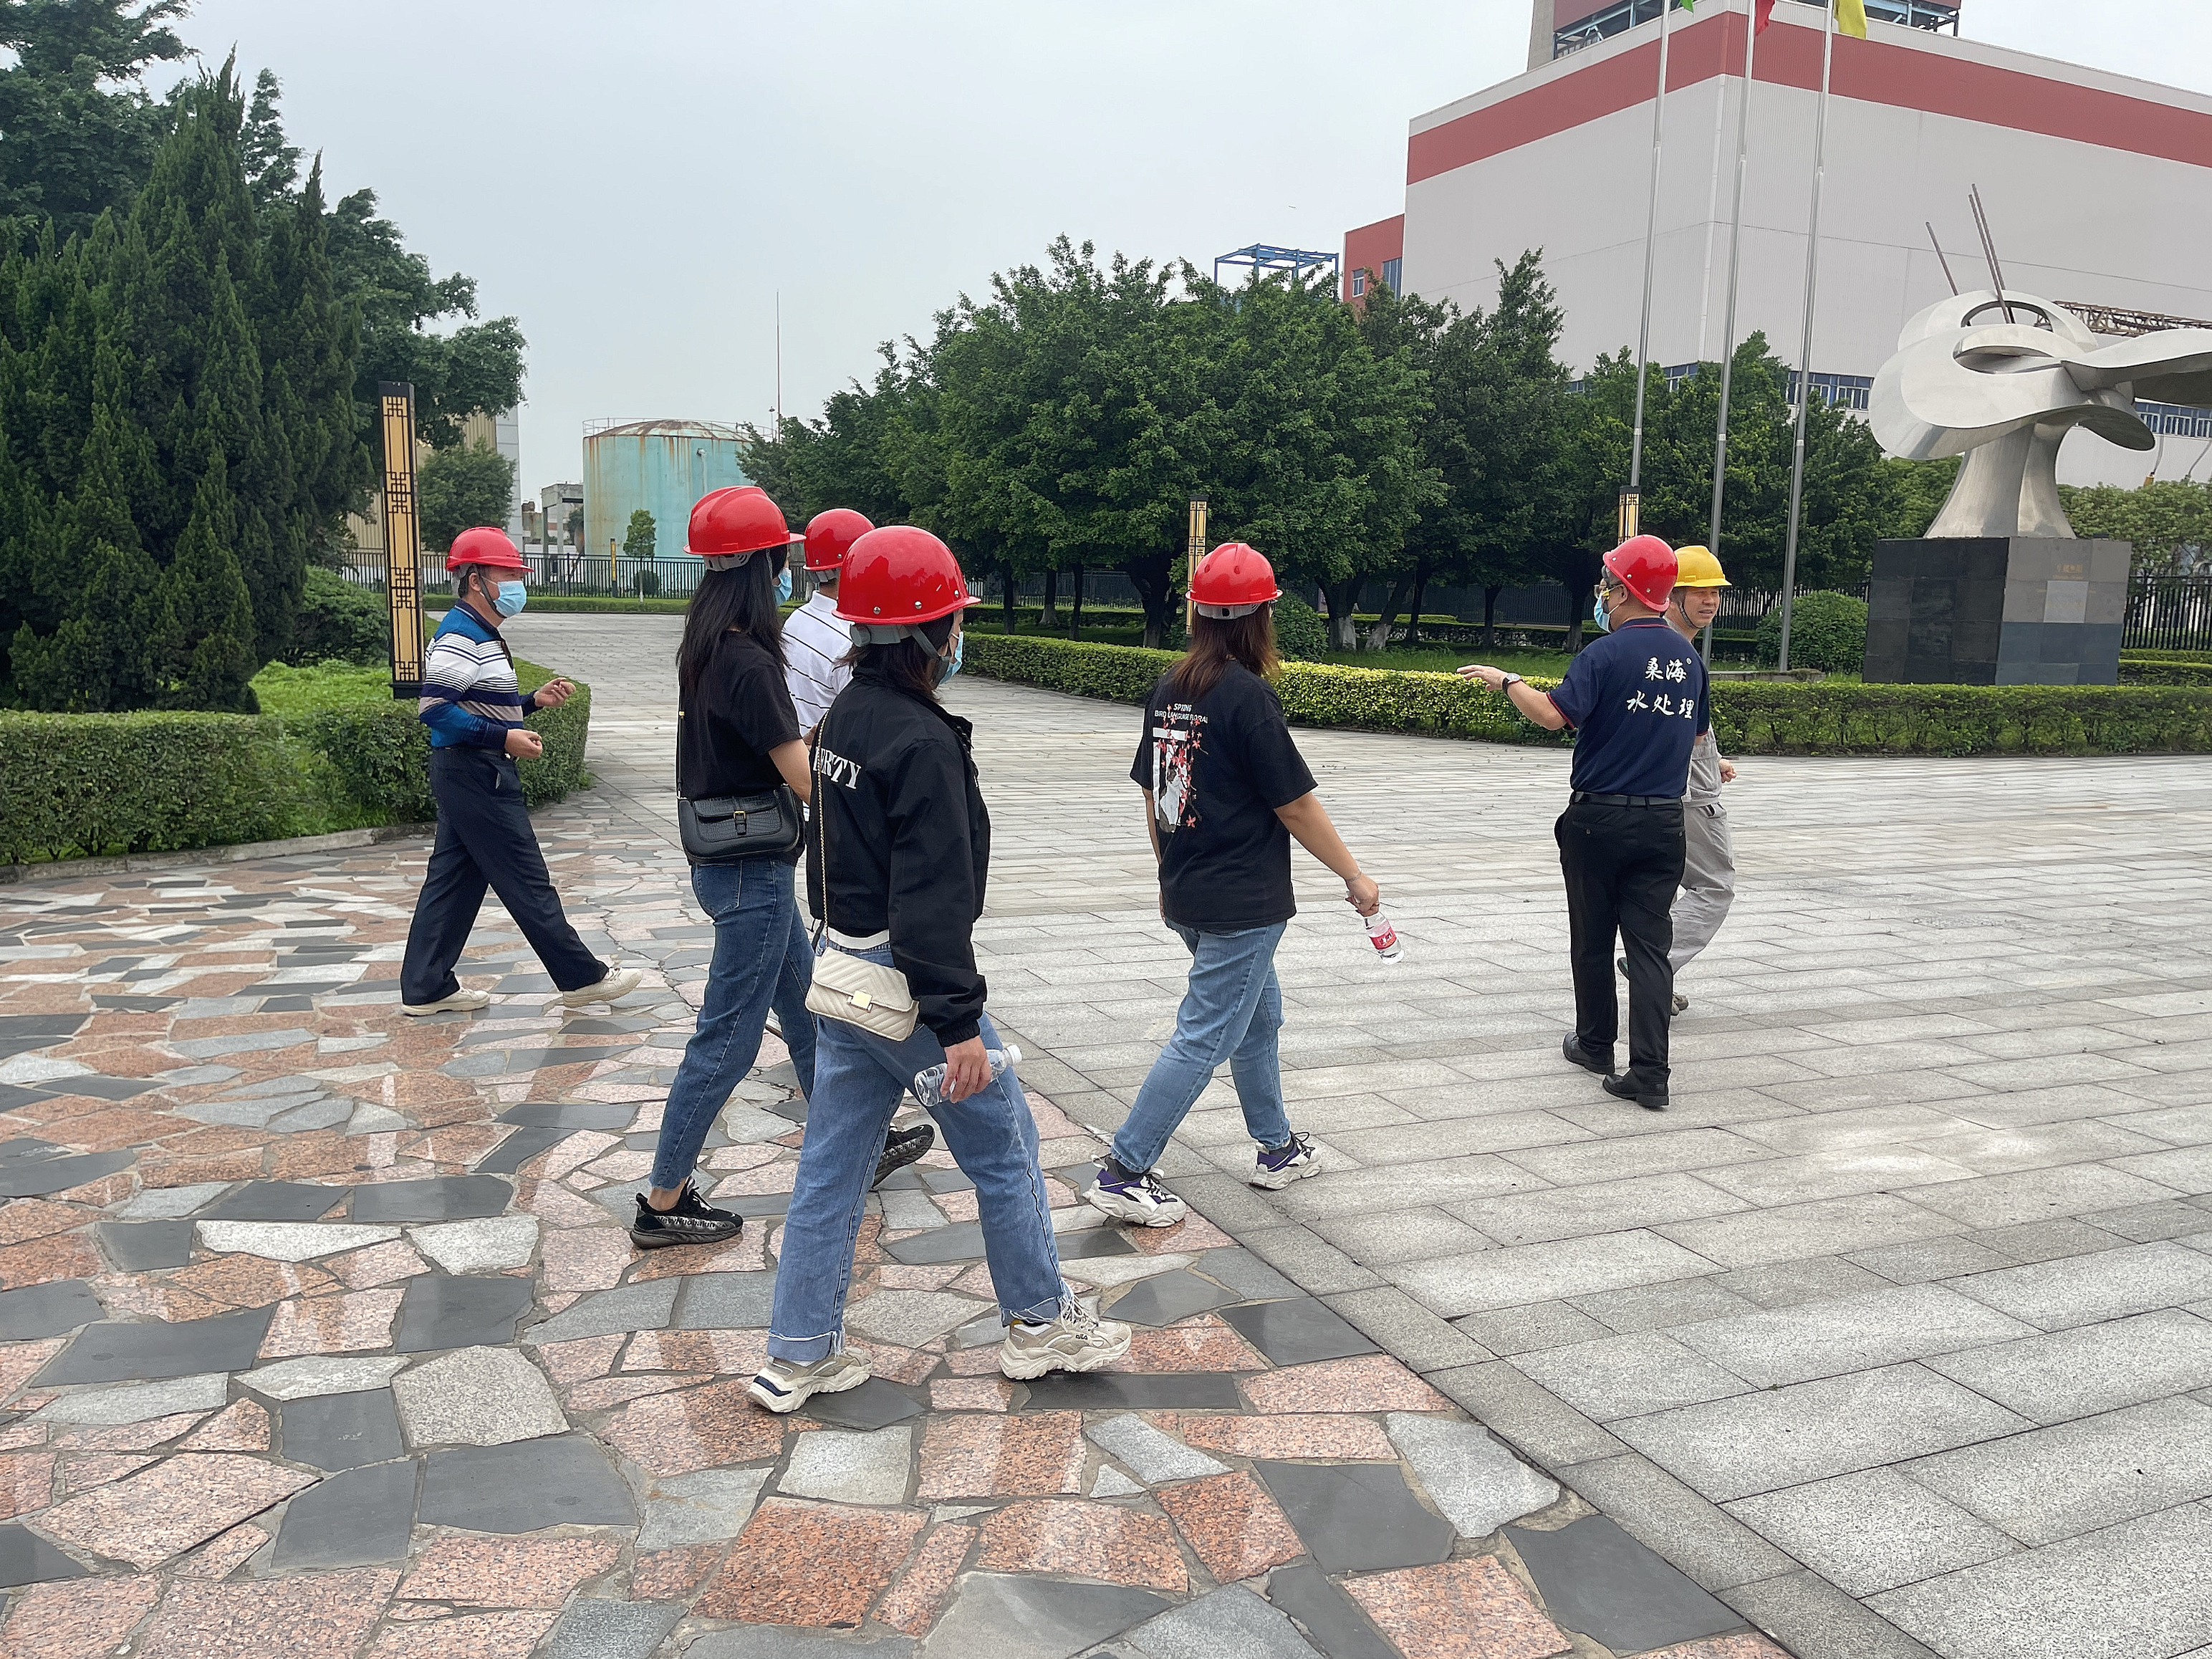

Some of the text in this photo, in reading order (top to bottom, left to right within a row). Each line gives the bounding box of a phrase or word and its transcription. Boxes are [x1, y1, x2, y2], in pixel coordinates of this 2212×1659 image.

[1645, 656, 1687, 683] 桑海
[1626, 690, 1695, 719] 水处理
